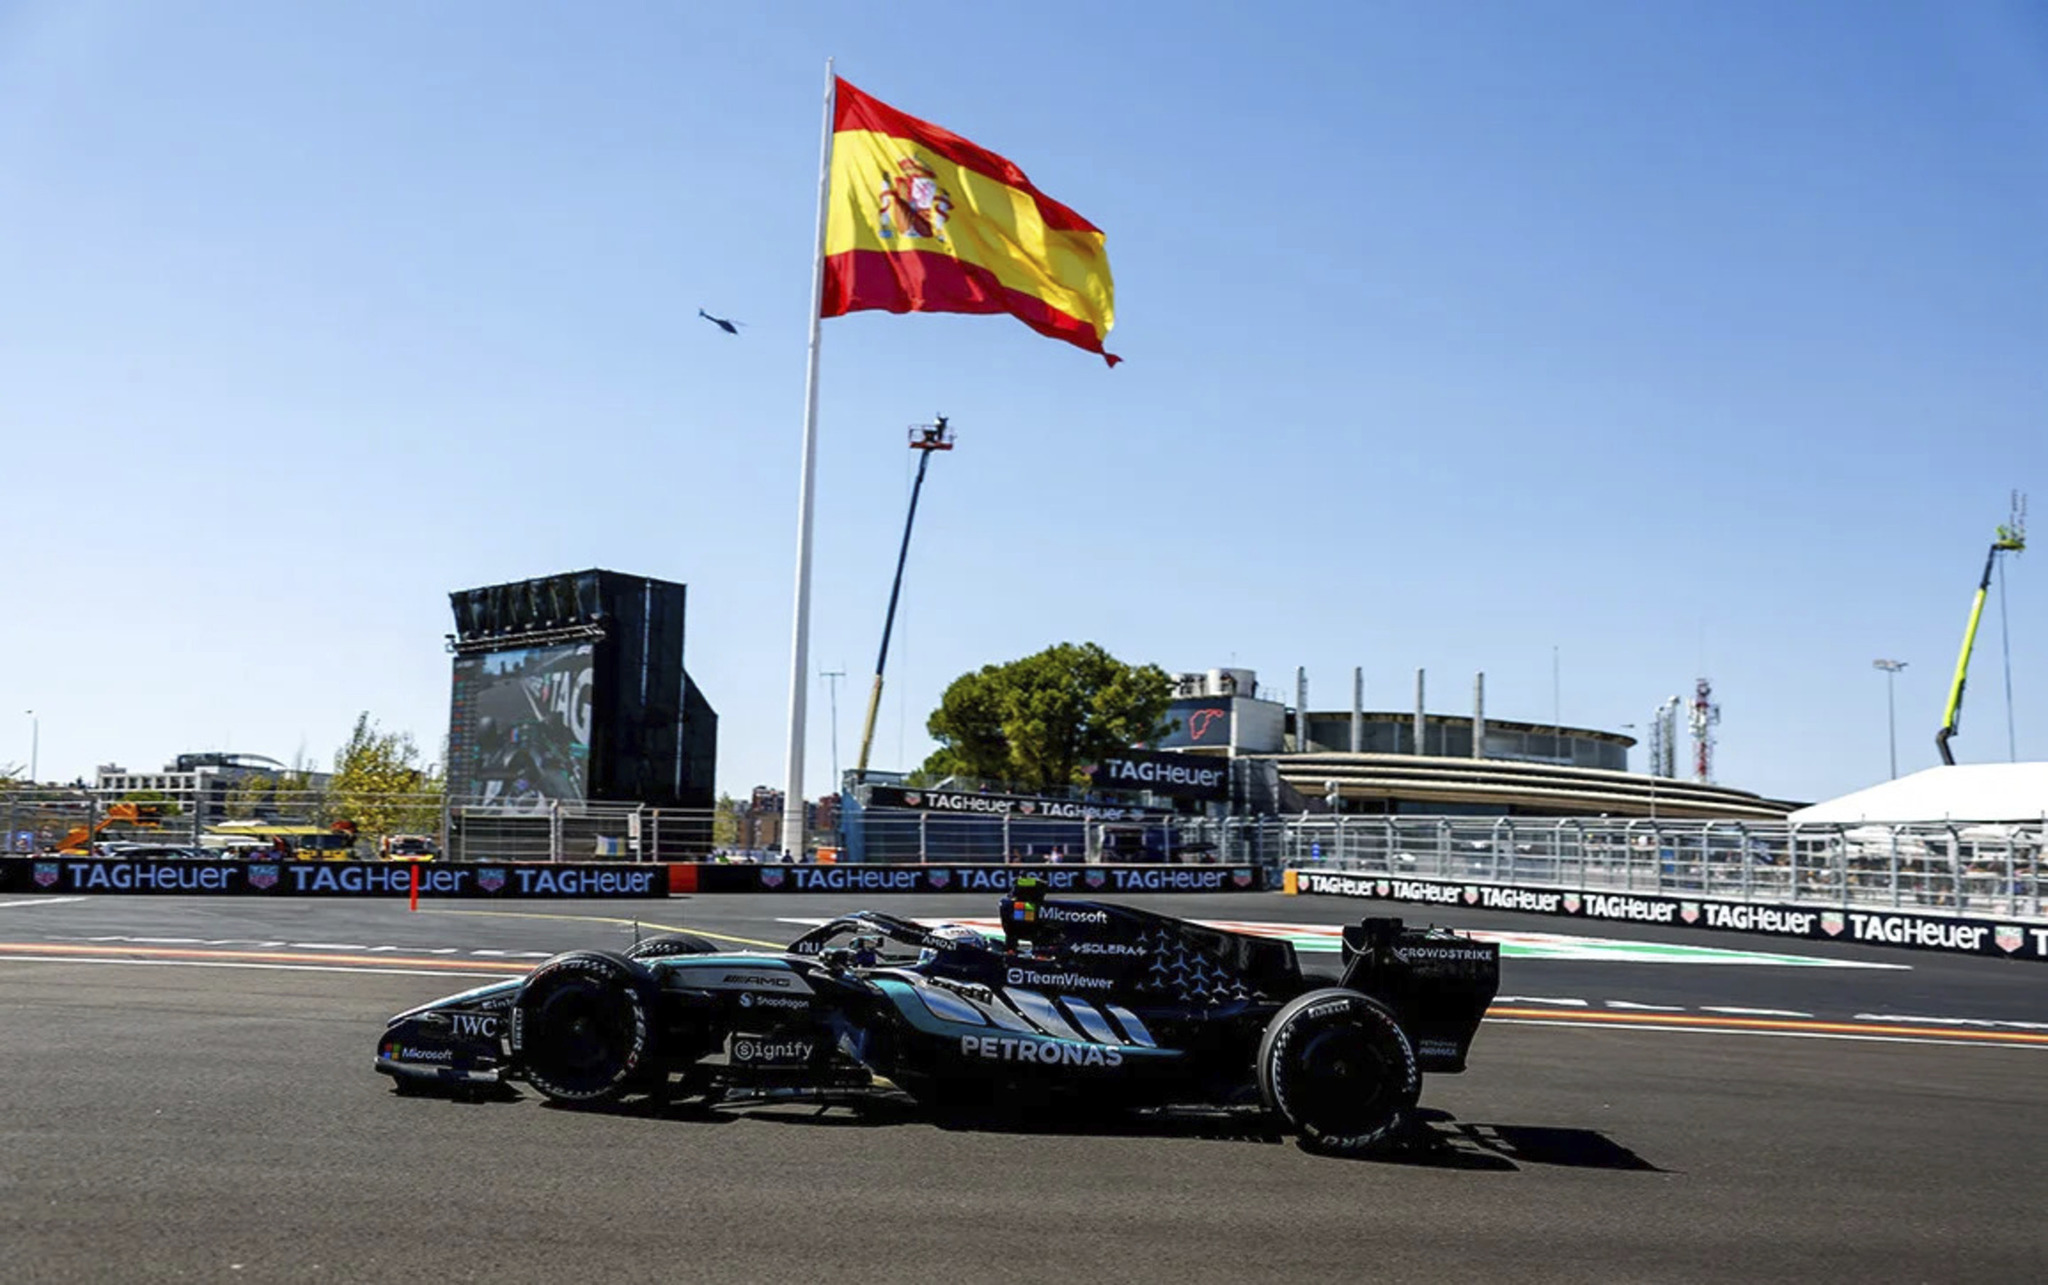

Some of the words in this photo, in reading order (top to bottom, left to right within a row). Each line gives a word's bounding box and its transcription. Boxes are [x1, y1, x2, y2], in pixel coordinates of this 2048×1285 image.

[1105, 758, 1223, 787] TAGHeuer
[925, 793, 1015, 814] TAGHeuer
[1039, 802, 1125, 821] TAGHeuer
[67, 863, 238, 889] TAGHeuer
[515, 869, 654, 893] TAGHeuer
[791, 868, 922, 888] TAGHeuer
[1112, 869, 1227, 888] TAGHeuer
[1310, 875, 1374, 896] TAGHeuer
[1391, 881, 1462, 904] TAGHeuer
[1479, 887, 1561, 912] TAGHeuer
[1038, 906, 1108, 924] Microsoft
[1582, 894, 1678, 922] TAGHeuer
[1703, 904, 1817, 934] TAGHeuer
[1849, 914, 1988, 949] TAGHeuer
[1081, 942, 1135, 956] SOLERA
[1400, 947, 1492, 960] CROWDSTRIKE
[745, 975, 790, 987] AMG
[1024, 970, 1114, 989] TeamViewer
[451, 1014, 497, 1037] IWC
[401, 1047, 453, 1060] Microsoft
[960, 1034, 1123, 1066] PETRONAS
